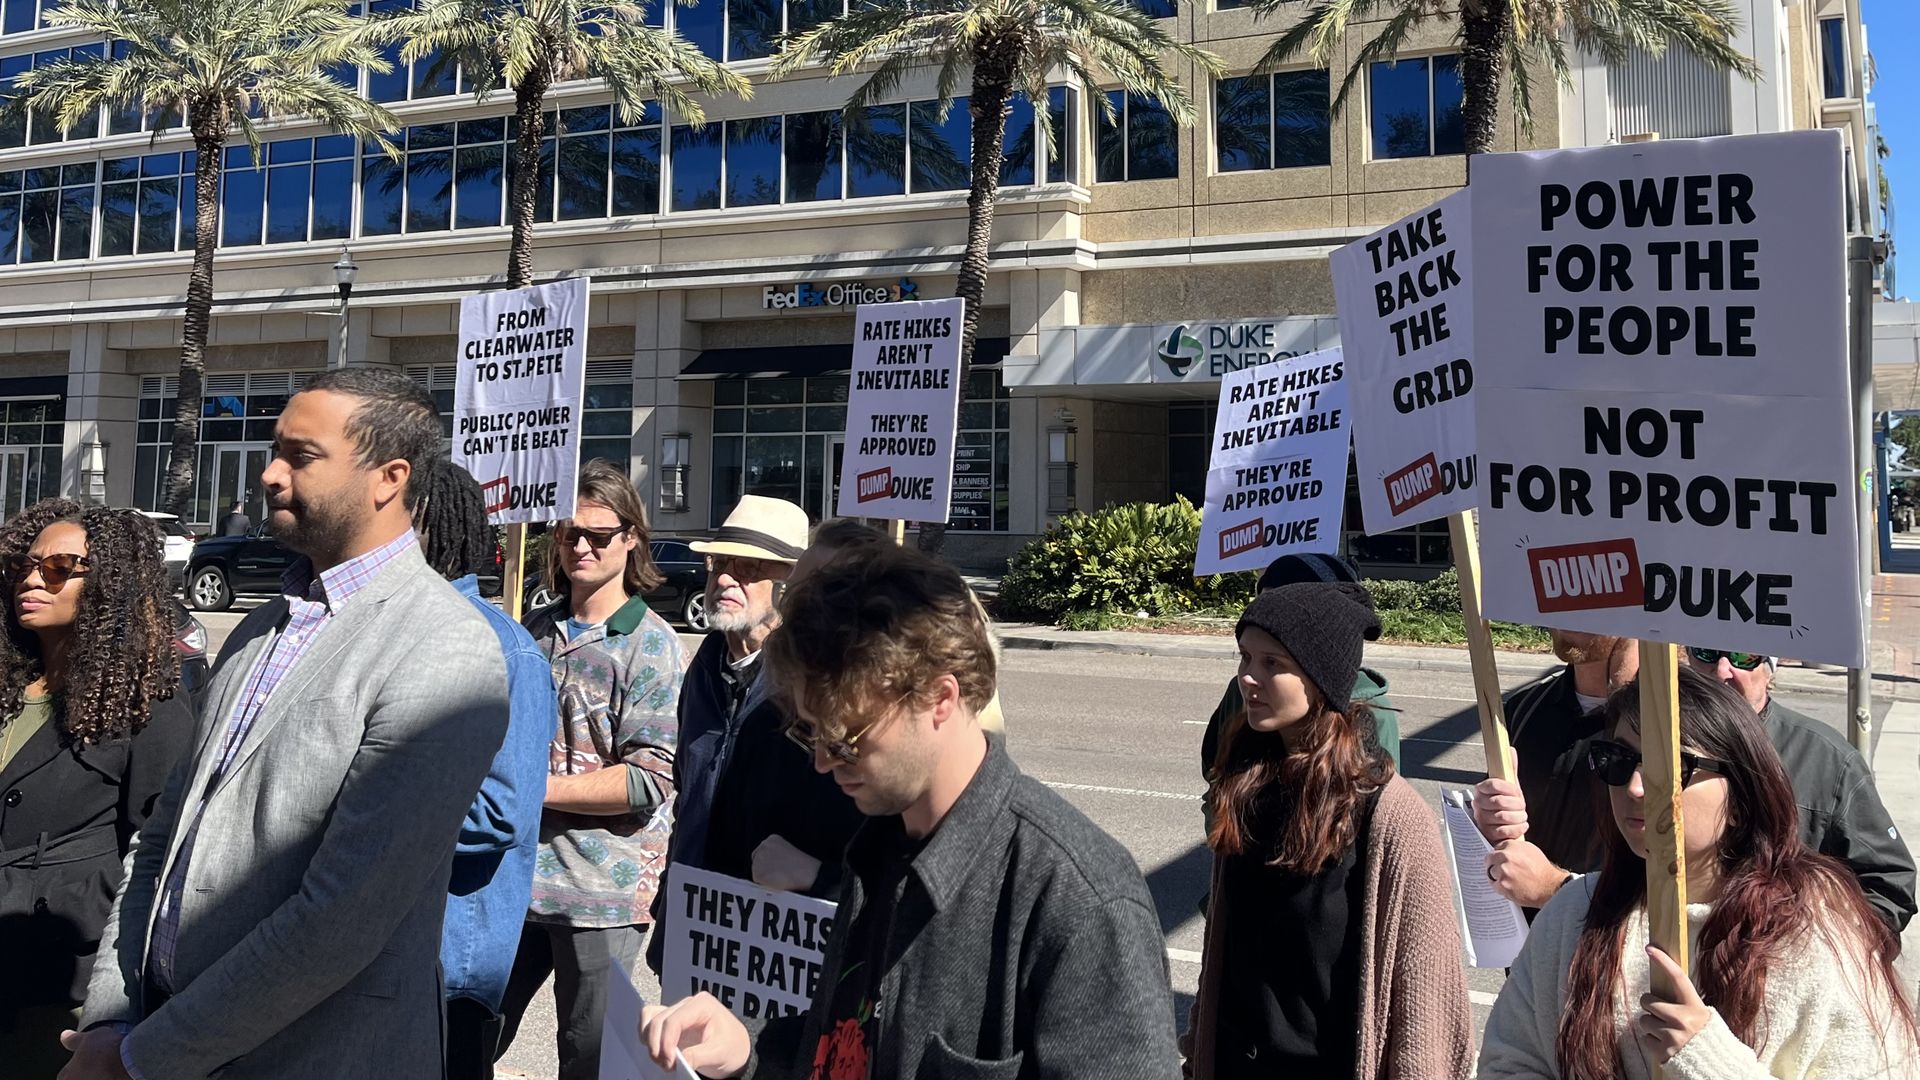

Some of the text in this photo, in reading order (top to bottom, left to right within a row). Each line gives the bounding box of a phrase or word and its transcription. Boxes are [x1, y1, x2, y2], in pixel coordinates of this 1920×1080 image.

[1540, 173, 1756, 231] POWER
[1366, 207, 1447, 274] TAKE
[1527, 239, 1760, 294] FOR THE
[762, 283, 887, 309] FedEx Office
[1374, 249, 1462, 318] BACK
[497, 307, 545, 332] FROM
[863, 317, 951, 341] RATE HIKES
[1389, 302, 1451, 357] THE
[1543, 305, 1757, 357] PEOPLE
[465, 327, 574, 360] CLEARWATER
[1210, 324, 1274, 349] DUKE
[876, 344, 932, 365] AREN'T
[476, 362, 498, 382] TO
[856, 369, 949, 390] INEVITABLE
[1230, 361, 1343, 404] RATE HIKES
[1393, 358, 1474, 414] GRID
[460, 406, 570, 434] PUBLIC POWER
[1247, 391, 1320, 423] AREN'T
[871, 414, 928, 433] THEY'RE
[1221, 409, 1341, 451] INEVITABLE
[1583, 406, 1704, 460] NOT
[463, 429, 569, 455] CAN'T BE BEAT
[859, 437, 936, 456] APPROVED
[956, 449, 975, 457] PRINT
[956, 463, 971, 471] SHIP
[959, 477, 989, 485] BANNERS
[1235, 459, 1312, 487] THEY'RE
[1390, 454, 1478, 507] DUMP DU
[483, 482, 557, 510] MP DUKE
[860, 473, 889, 497] DUMP
[890, 476, 934, 500] DUKE
[953, 491, 983, 499] SUPPLIES
[1222, 480, 1322, 513] APPROVED
[1489, 462, 1837, 535] FOR PROFIT
[954, 506, 971, 514] MAIL
[1223, 517, 1319, 551] DUMP DUKE
[1537, 551, 1793, 627] DUMP DUKE
[683, 882, 833, 953] THEY RAIS
[689, 930, 822, 999] THE RATE
